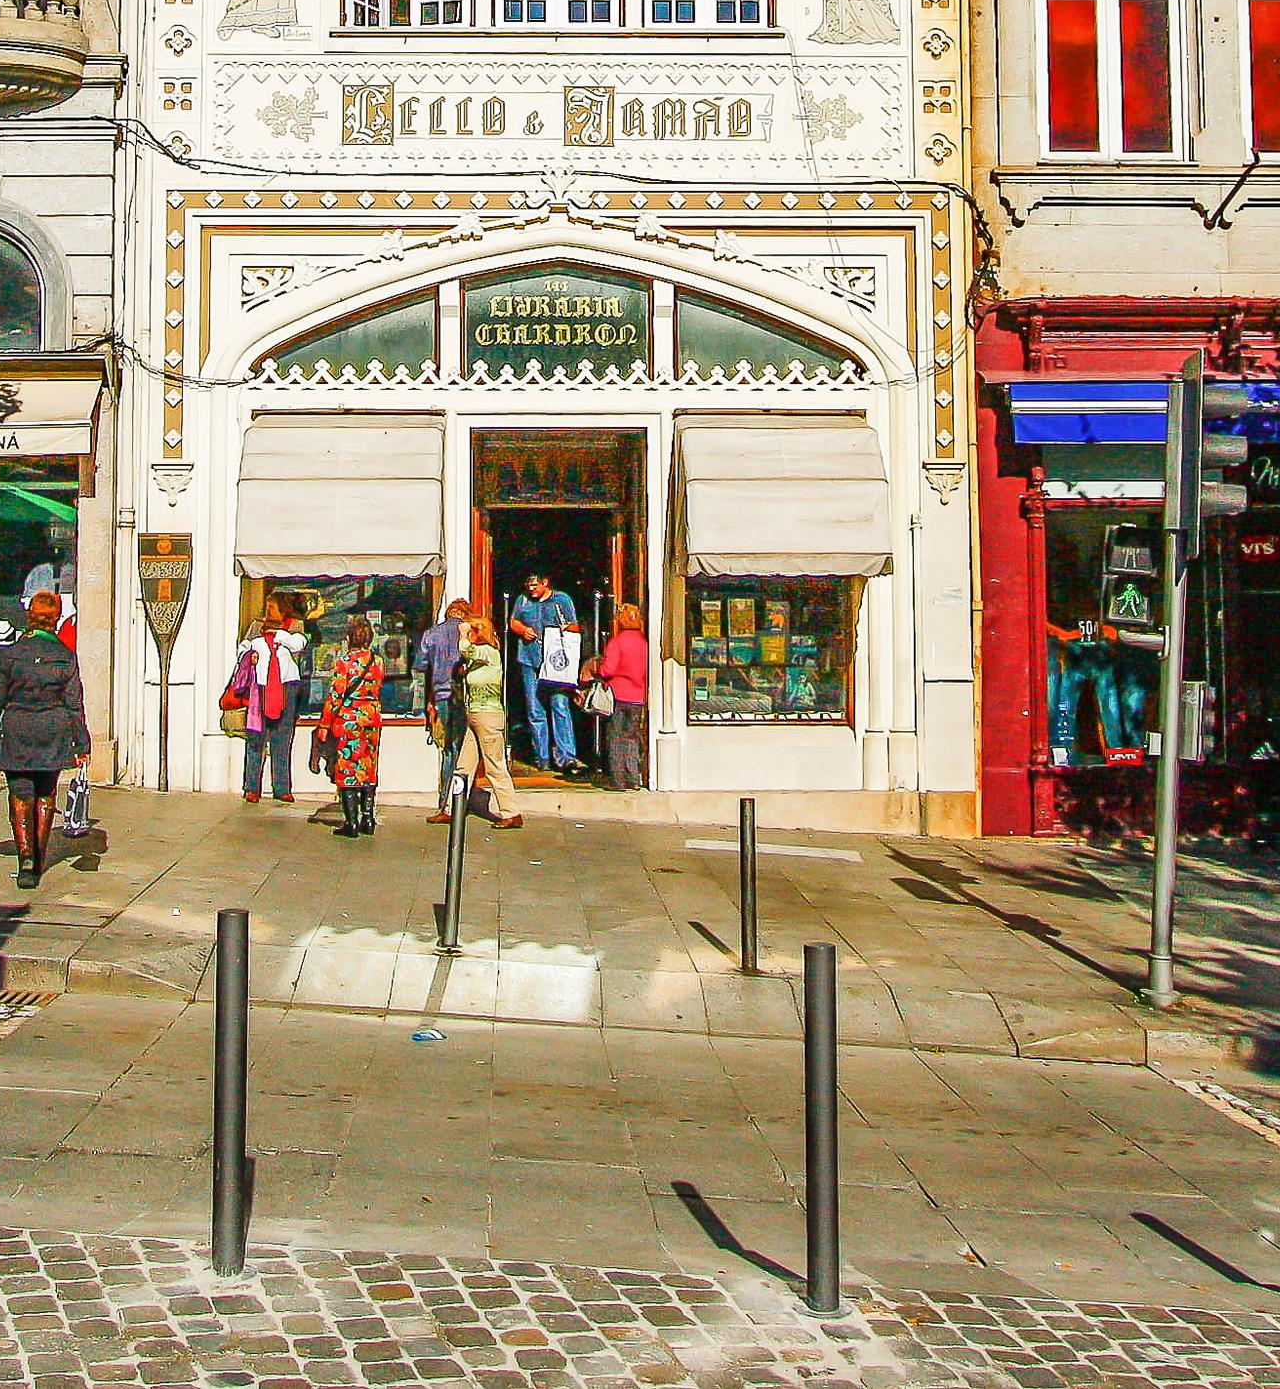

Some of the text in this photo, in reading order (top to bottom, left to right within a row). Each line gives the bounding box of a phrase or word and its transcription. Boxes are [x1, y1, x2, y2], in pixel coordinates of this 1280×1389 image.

[343, 85, 761, 147] LELLO & IRMÃO
[488, 295, 624, 318] LIVRARIA
[475, 323, 638, 347] CHARDRON
